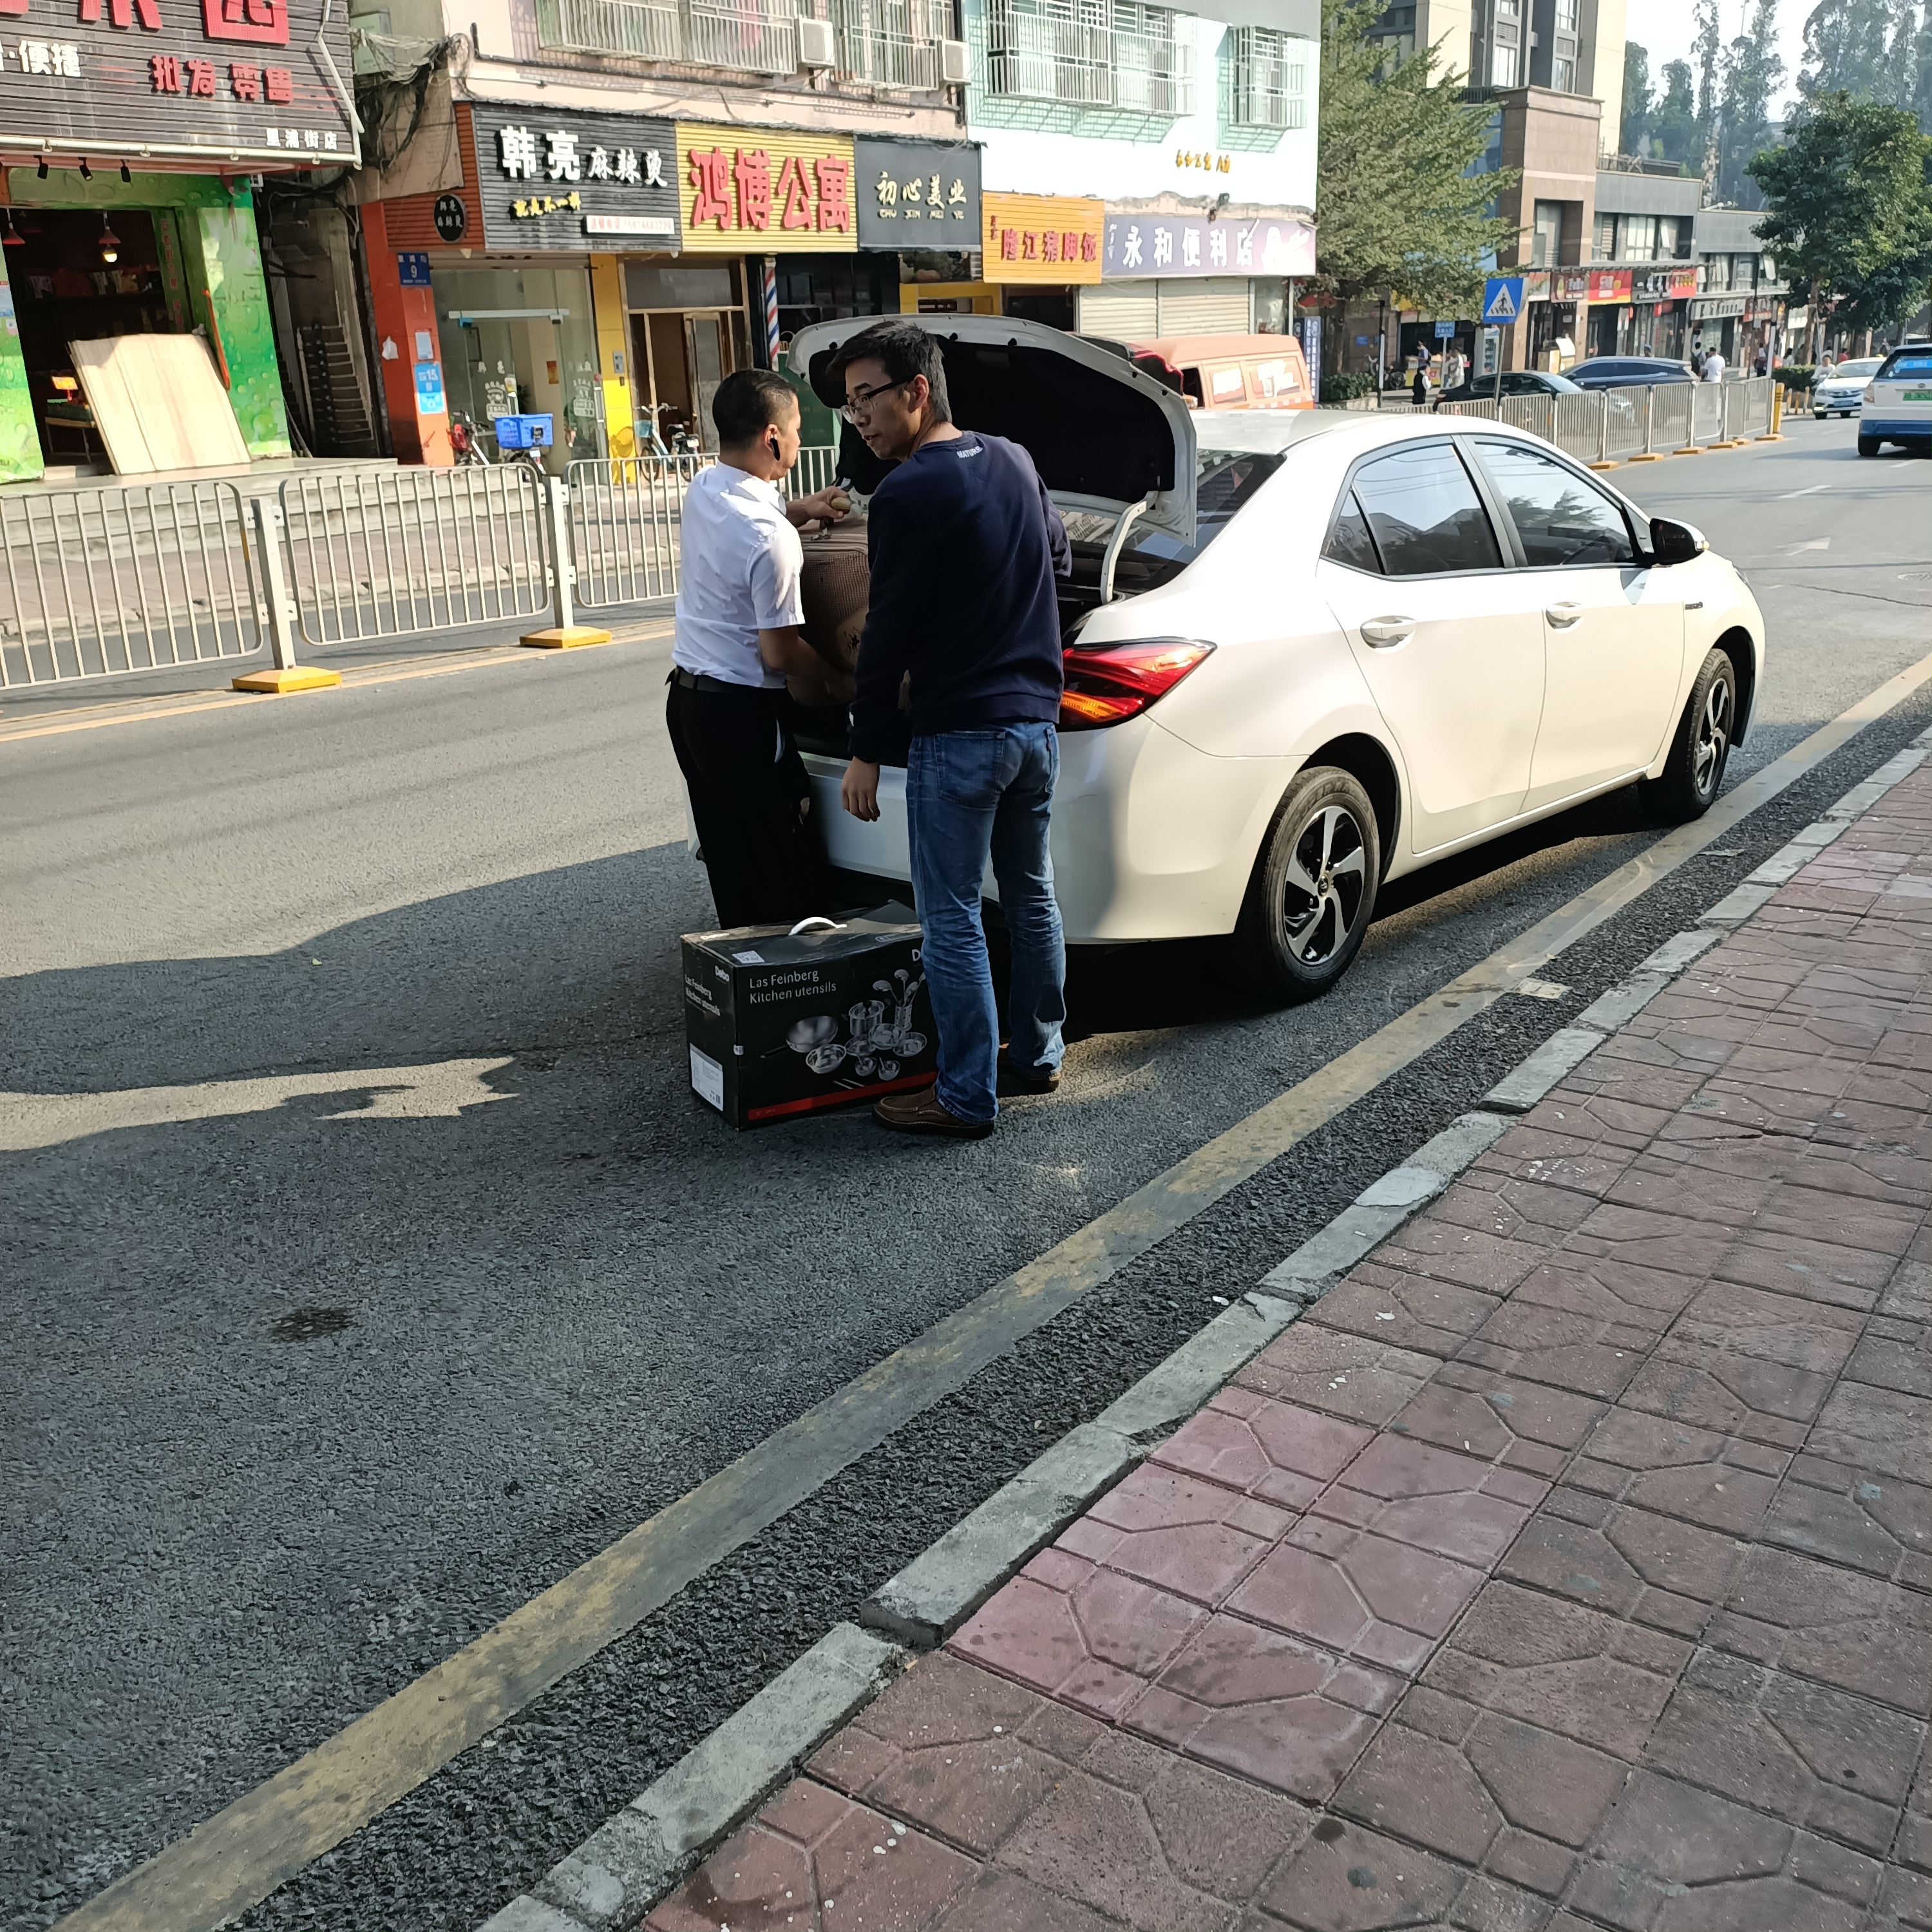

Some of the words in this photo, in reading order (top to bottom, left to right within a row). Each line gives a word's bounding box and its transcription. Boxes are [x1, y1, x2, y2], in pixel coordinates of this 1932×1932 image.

[500, 126, 580, 180] 韩亮
[588, 145, 668, 187] 麻辣烫
[689, 146, 850, 232] 鸿博公寓
[876, 171, 967, 210] 初心美业
[1001, 229, 1097, 263] 隆江猪脚饭
[1122, 225, 1253, 268] 永和便利店
[750, 978, 768, 989] Las
[771, 970, 820, 986] Feinberg
[750, 989, 793, 1005] Kitchen
[795, 981, 837, 998] utensils
